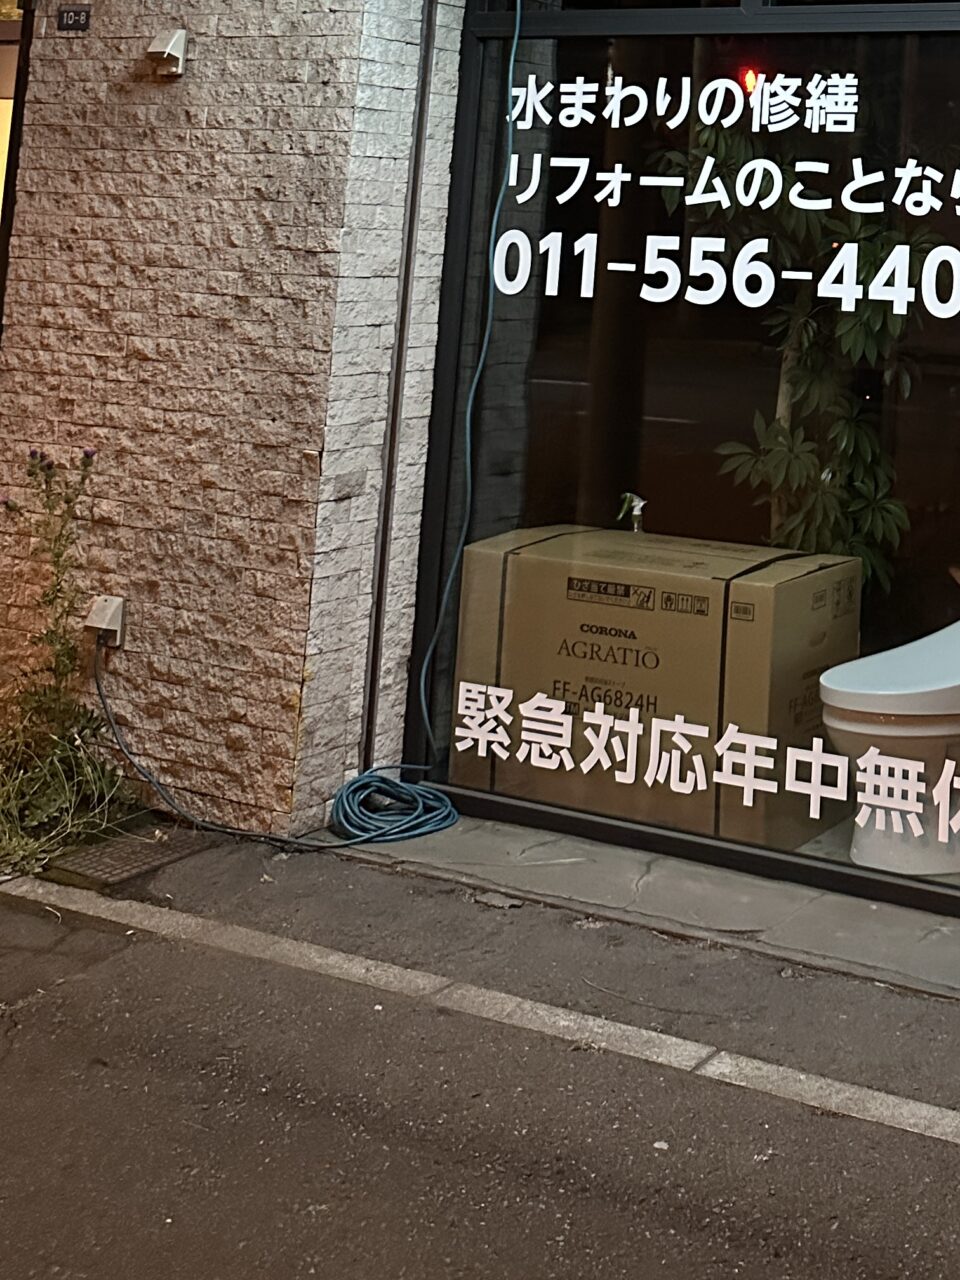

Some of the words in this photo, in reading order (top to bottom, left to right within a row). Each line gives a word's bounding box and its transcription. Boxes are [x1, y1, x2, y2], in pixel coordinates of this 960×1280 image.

[63, 12, 87, 24] 10-8
[505, 72, 860, 134] 水まわりの修繕
[579, 623, 638, 639] CORONA
[557, 638, 660, 670] AGRATIO
[552, 679, 658, 713] FF-AG6824H
